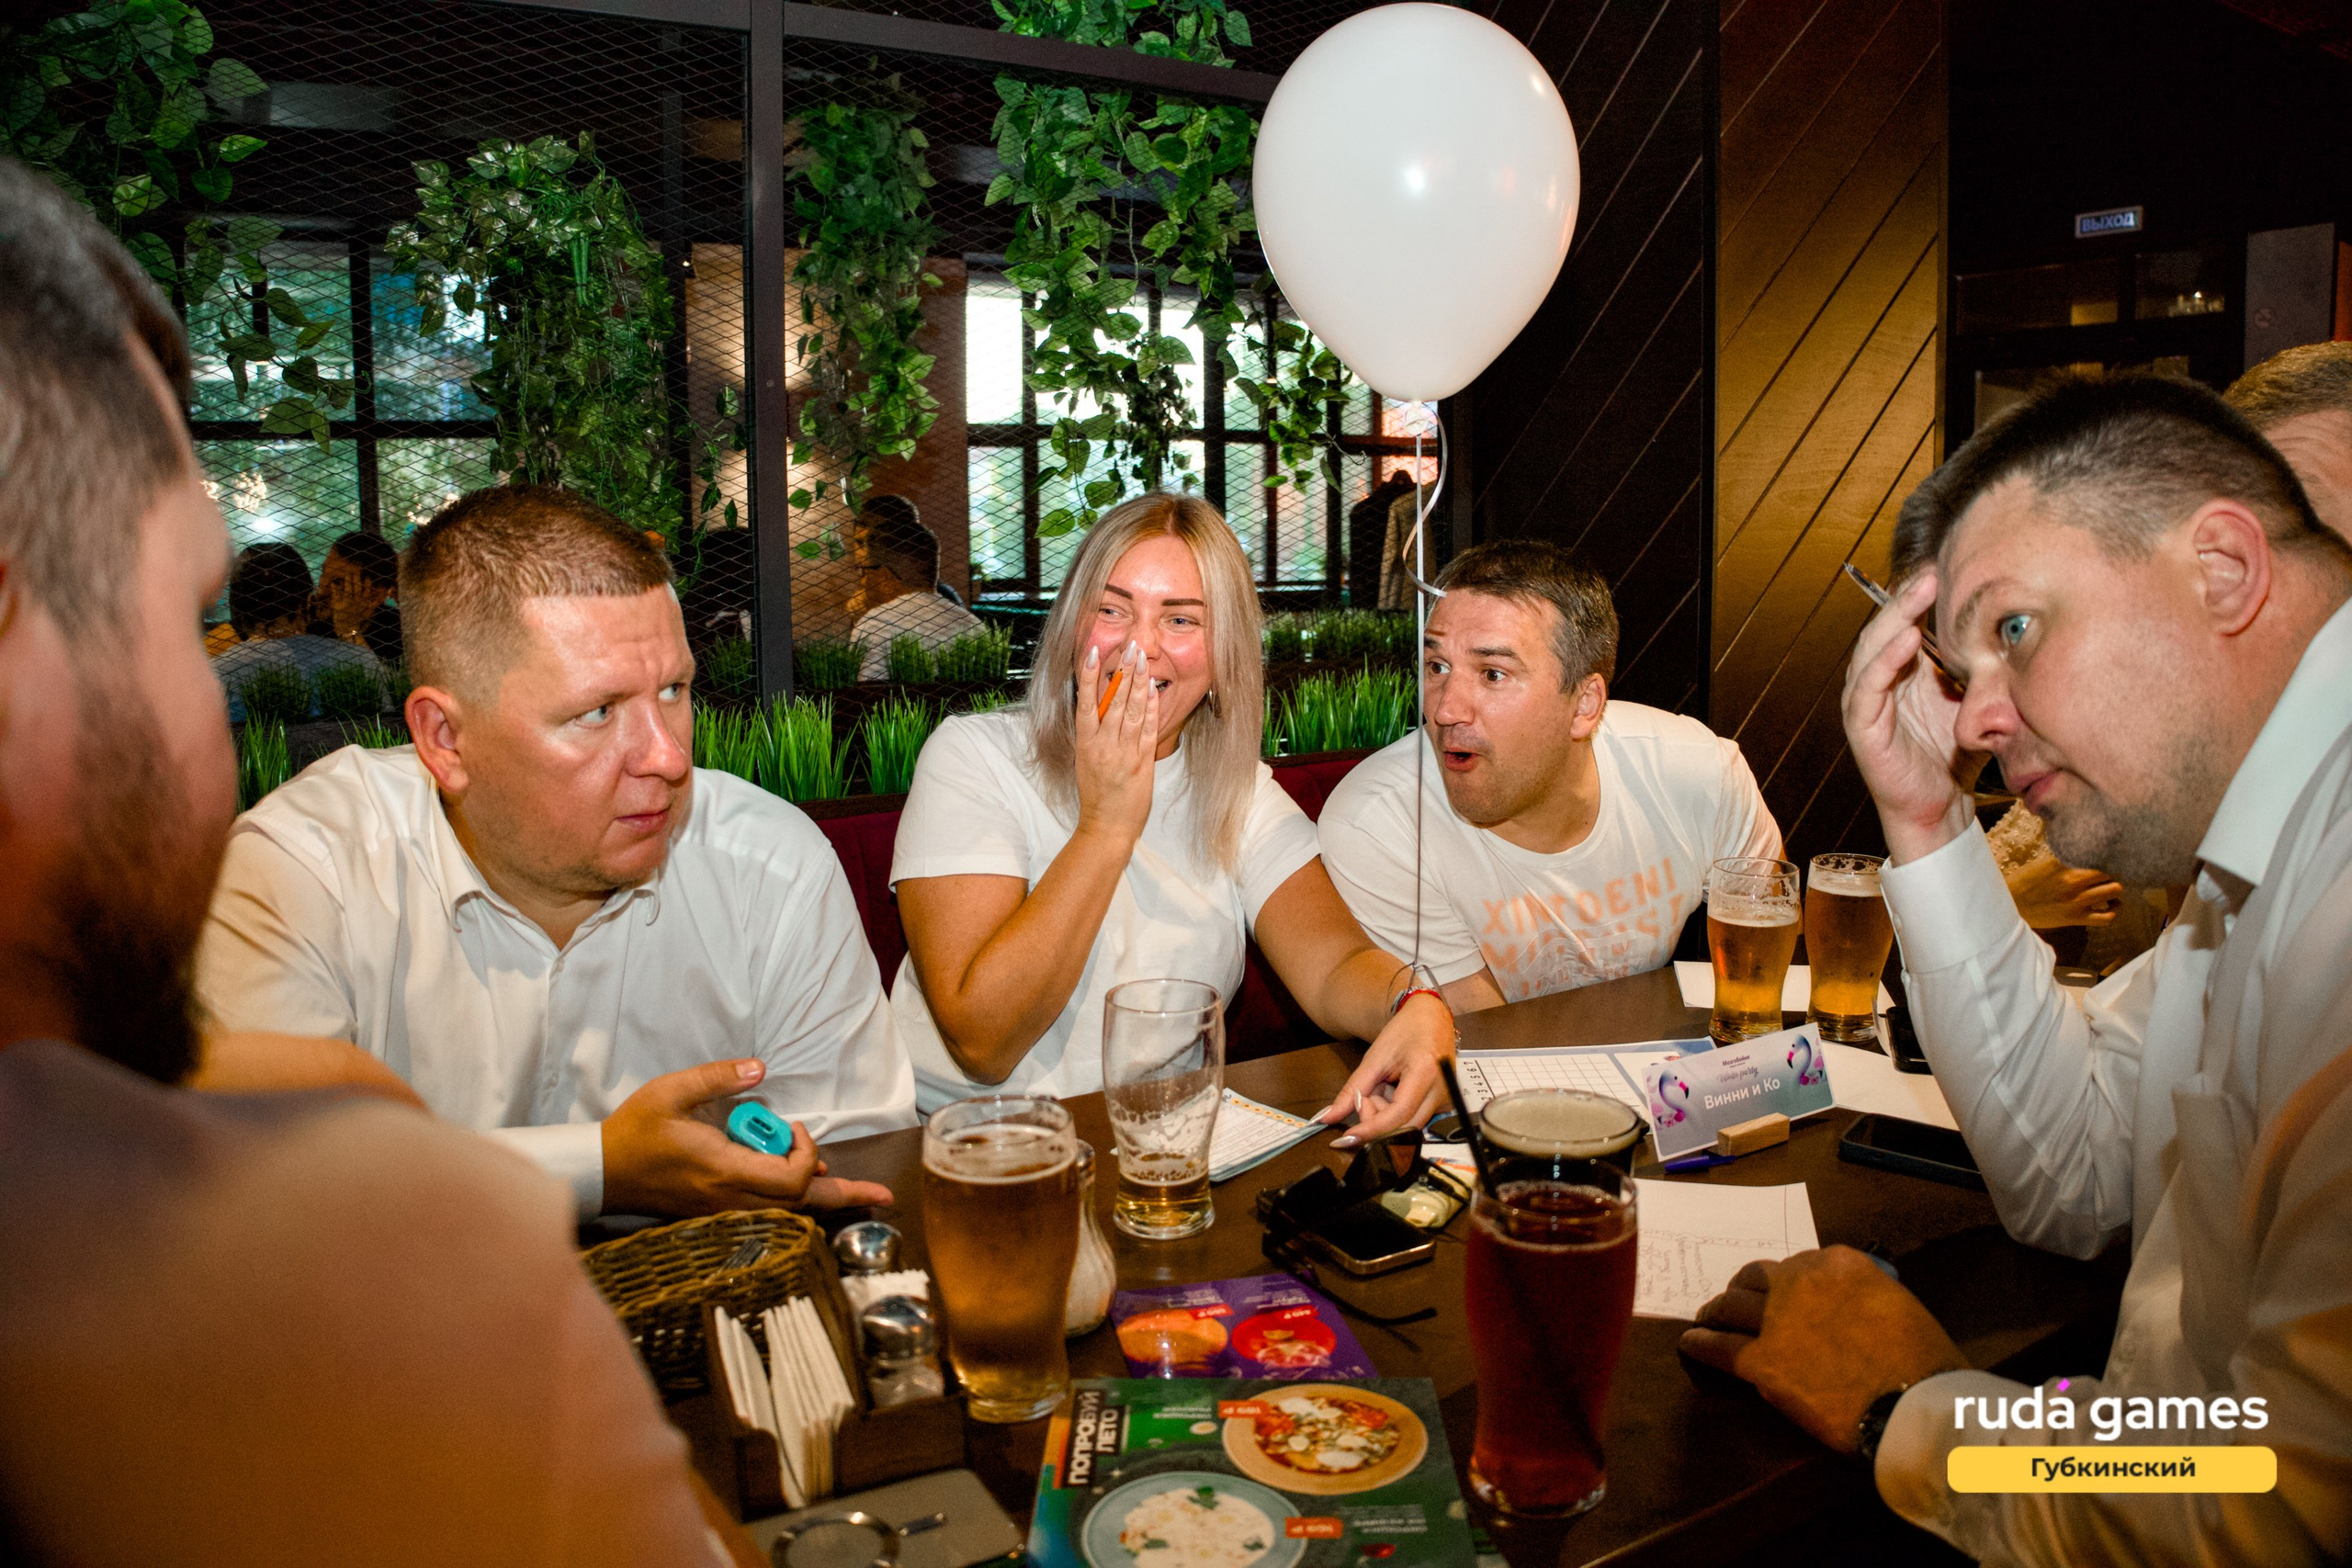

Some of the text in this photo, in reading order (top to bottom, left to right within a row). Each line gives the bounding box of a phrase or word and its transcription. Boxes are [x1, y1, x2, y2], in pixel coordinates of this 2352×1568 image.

[2081, 212, 2135, 232] ВЫХОД
[1703, 1077, 1781, 1110] Винни и Ко
[1068, 1391, 1102, 1484] ПОПРОБУЙ
[1095, 1409, 1119, 1452] ЛЕТО
